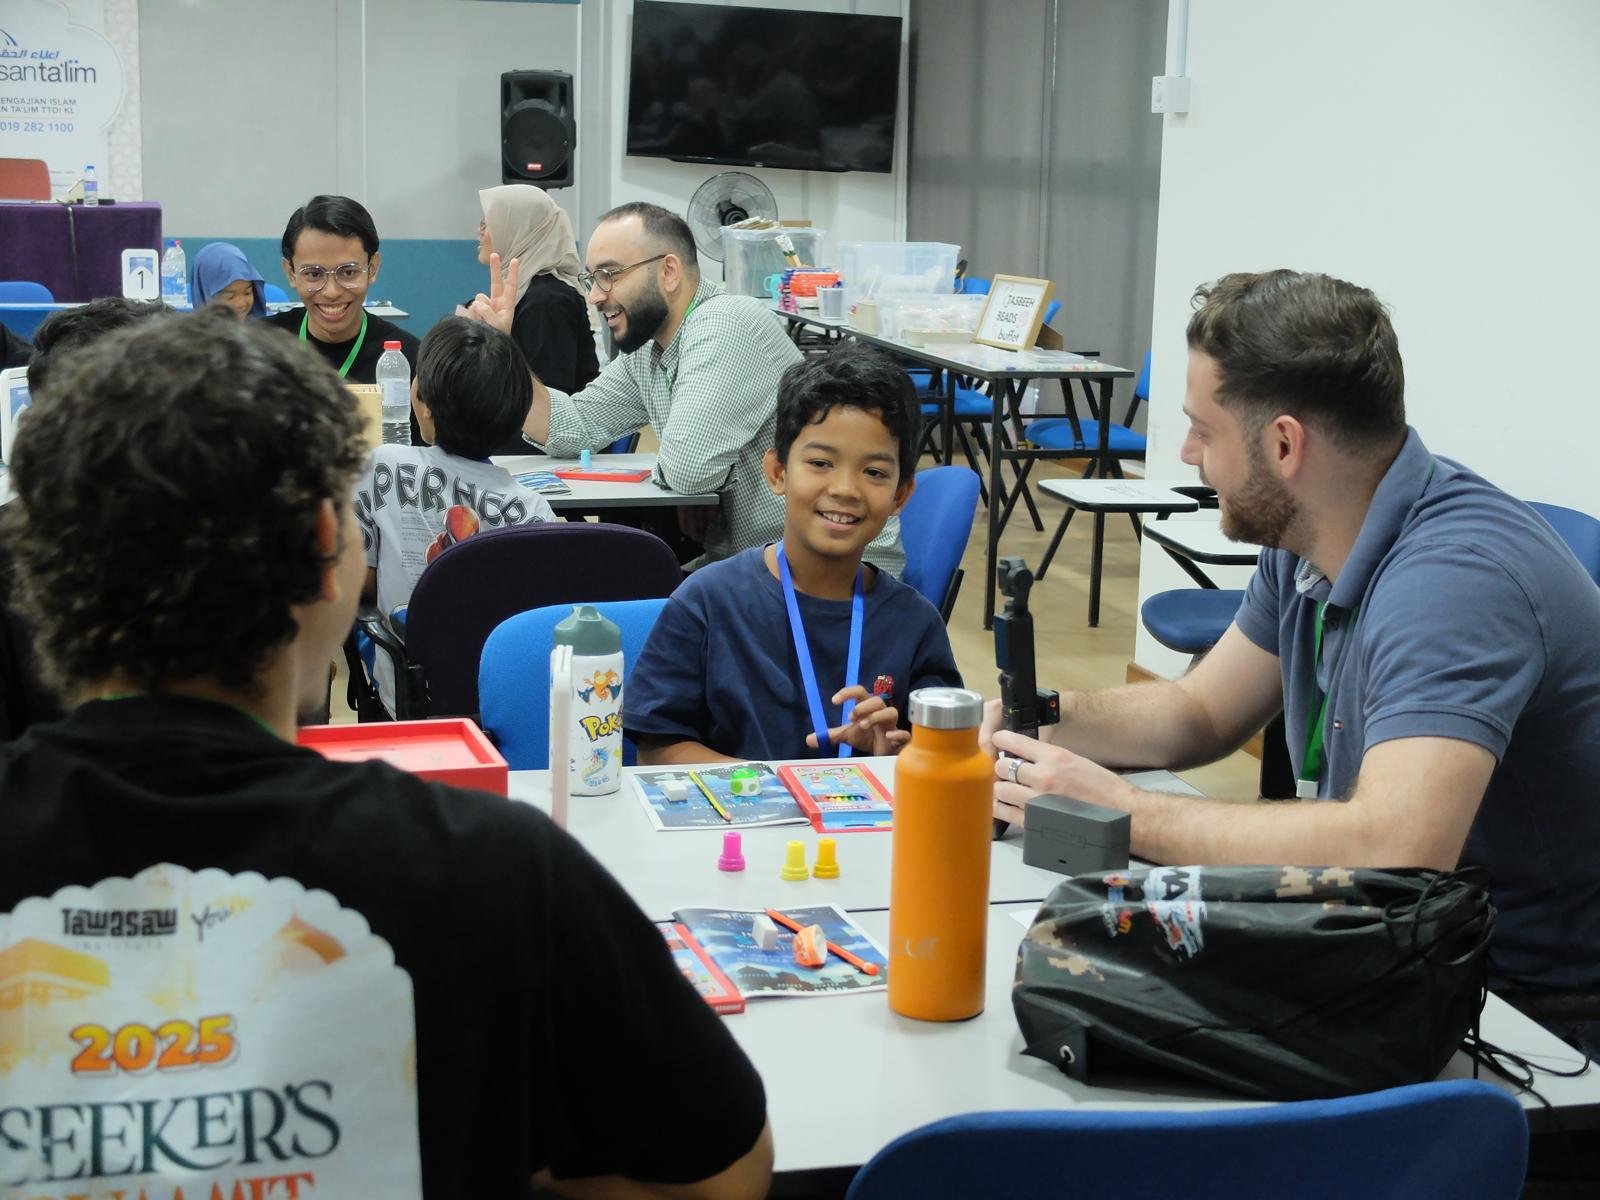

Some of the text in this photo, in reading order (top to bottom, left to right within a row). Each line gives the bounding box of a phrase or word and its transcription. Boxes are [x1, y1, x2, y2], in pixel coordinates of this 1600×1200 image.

[49, 98, 77, 106] ISLAM
[0, 121, 74, 133] 019 282 1100
[137, 270, 144, 289] 1
[996, 310, 1018, 324] BEADS
[69, 1013, 238, 1077] 2025
